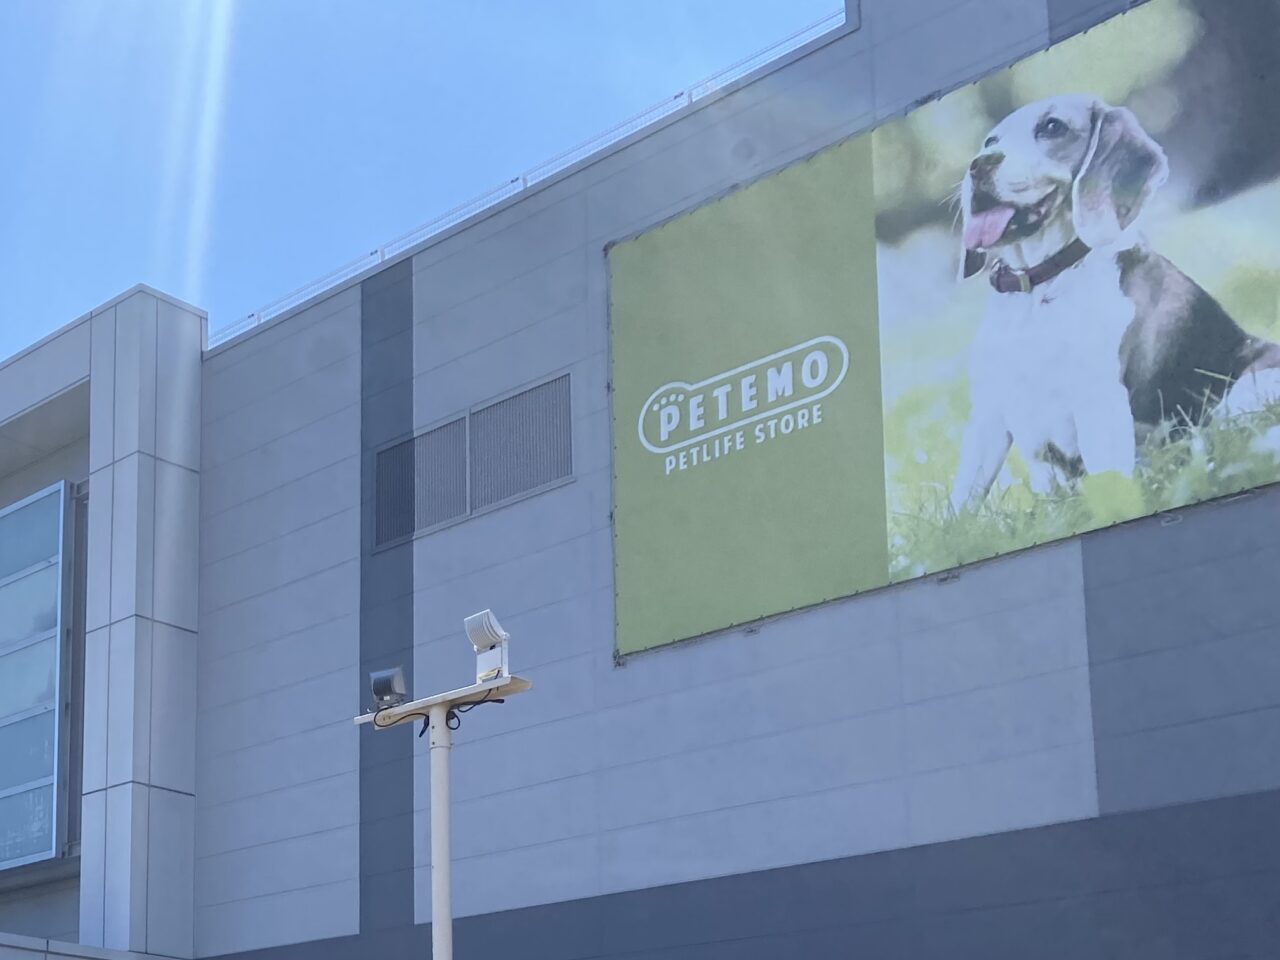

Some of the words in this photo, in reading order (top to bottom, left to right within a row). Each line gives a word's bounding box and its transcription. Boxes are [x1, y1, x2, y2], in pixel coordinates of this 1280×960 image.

[660, 350, 829, 442] PETEMO
[665, 430, 745, 475] PETLIFE
[755, 403, 823, 444] STORE
